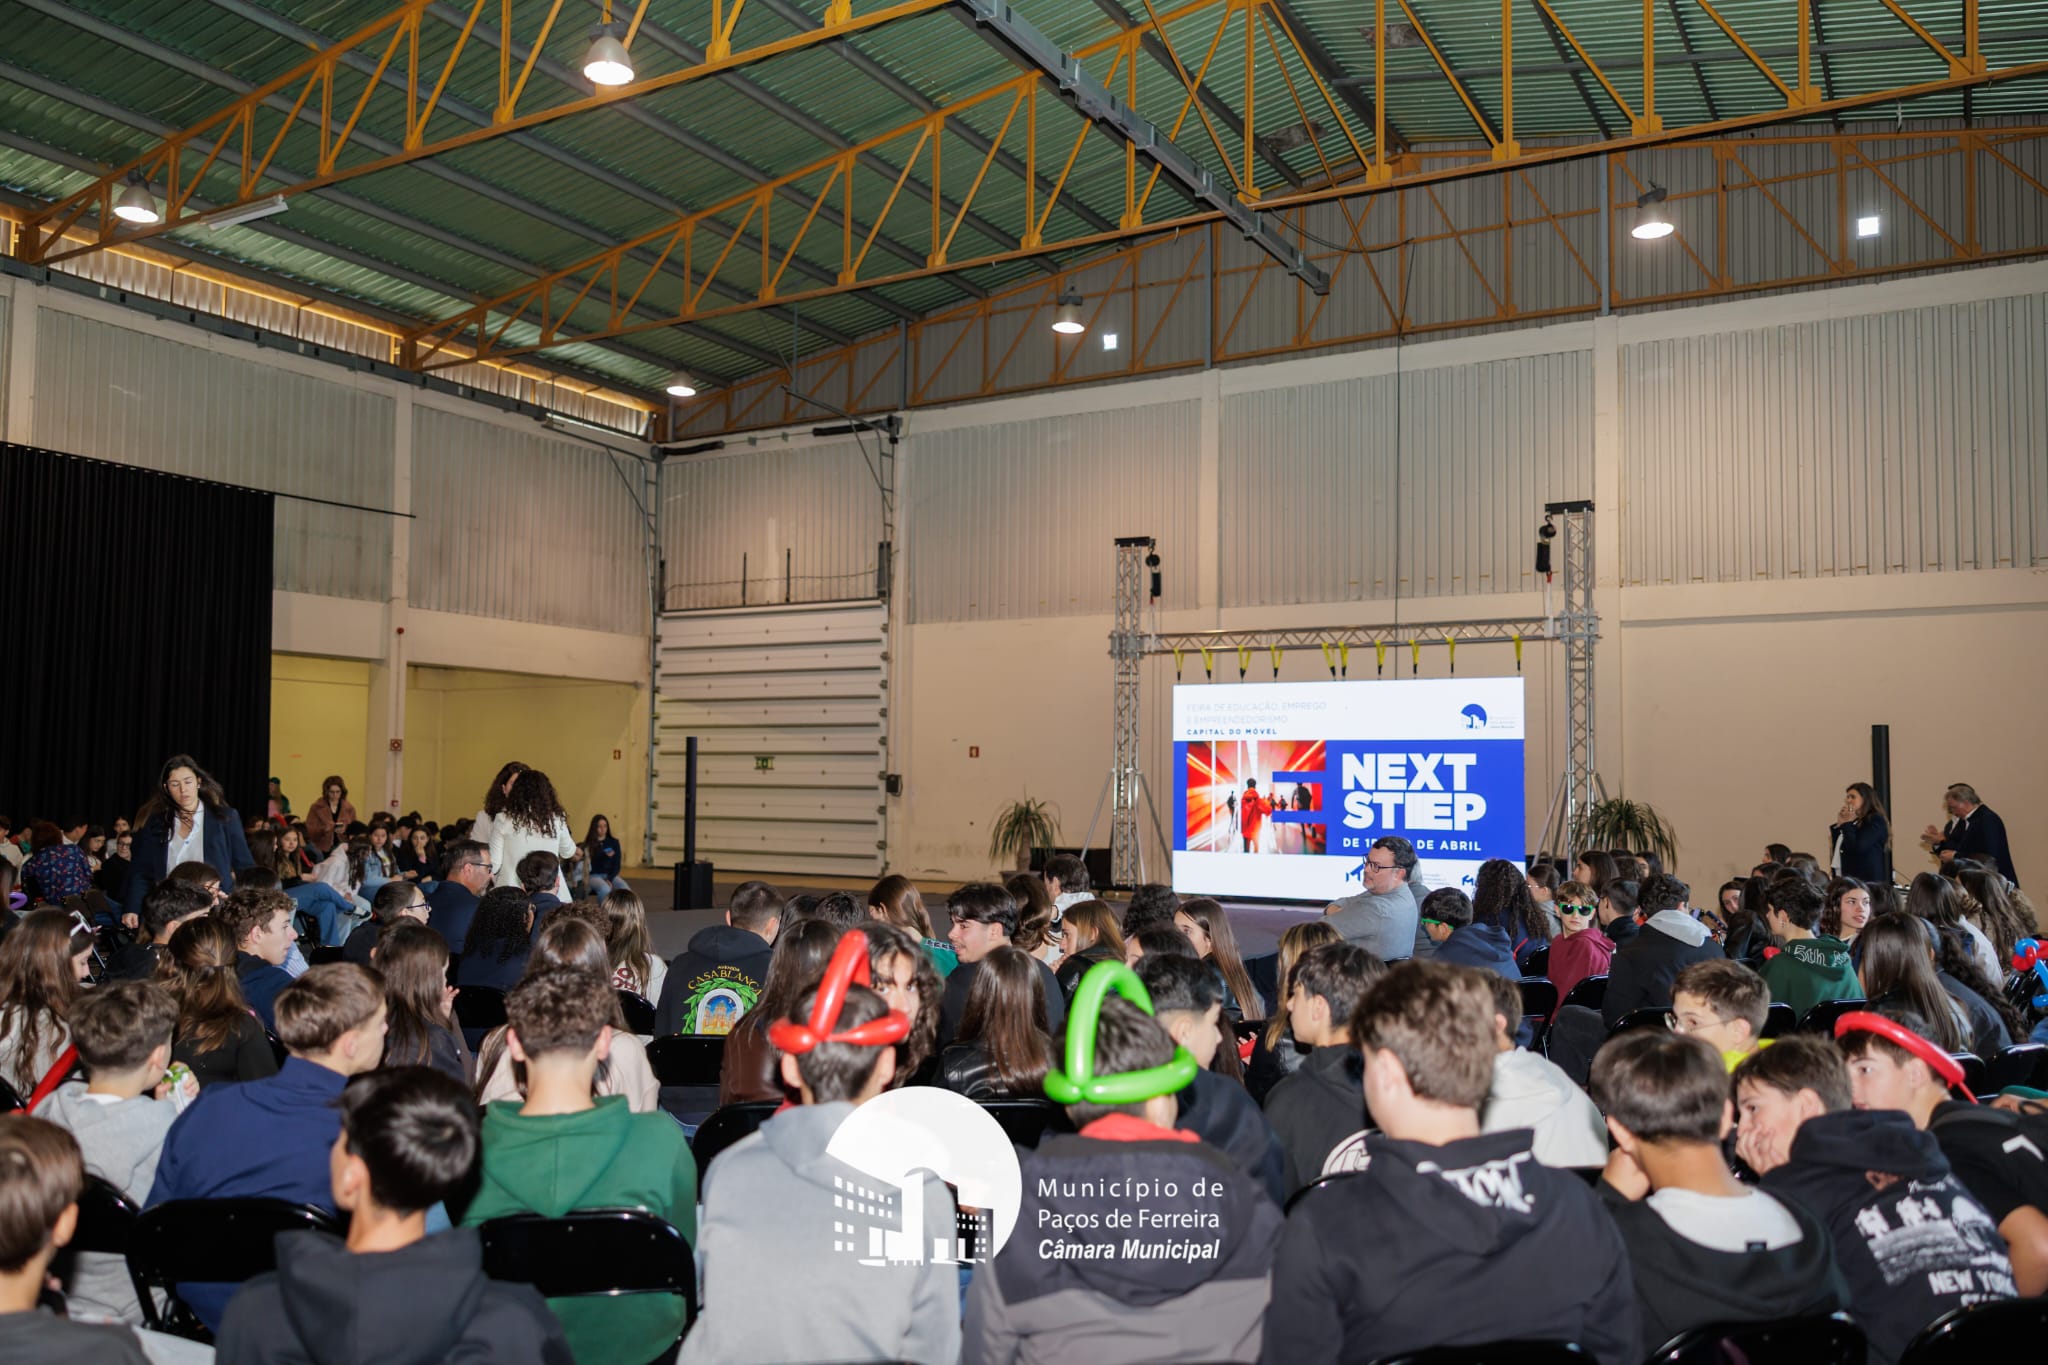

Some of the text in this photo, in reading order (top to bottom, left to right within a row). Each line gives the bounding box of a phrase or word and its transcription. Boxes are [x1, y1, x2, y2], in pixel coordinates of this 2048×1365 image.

[1281, 702, 1328, 711] EMPREGO
[1245, 727, 1278, 735] MÓVEL
[1342, 753, 1477, 791] NEXT
[1343, 837, 1360, 848] DE
[1416, 840, 1434, 850] DE
[1440, 840, 1482, 851] ABRIL
[1928, 1268, 1974, 1296] NEW
